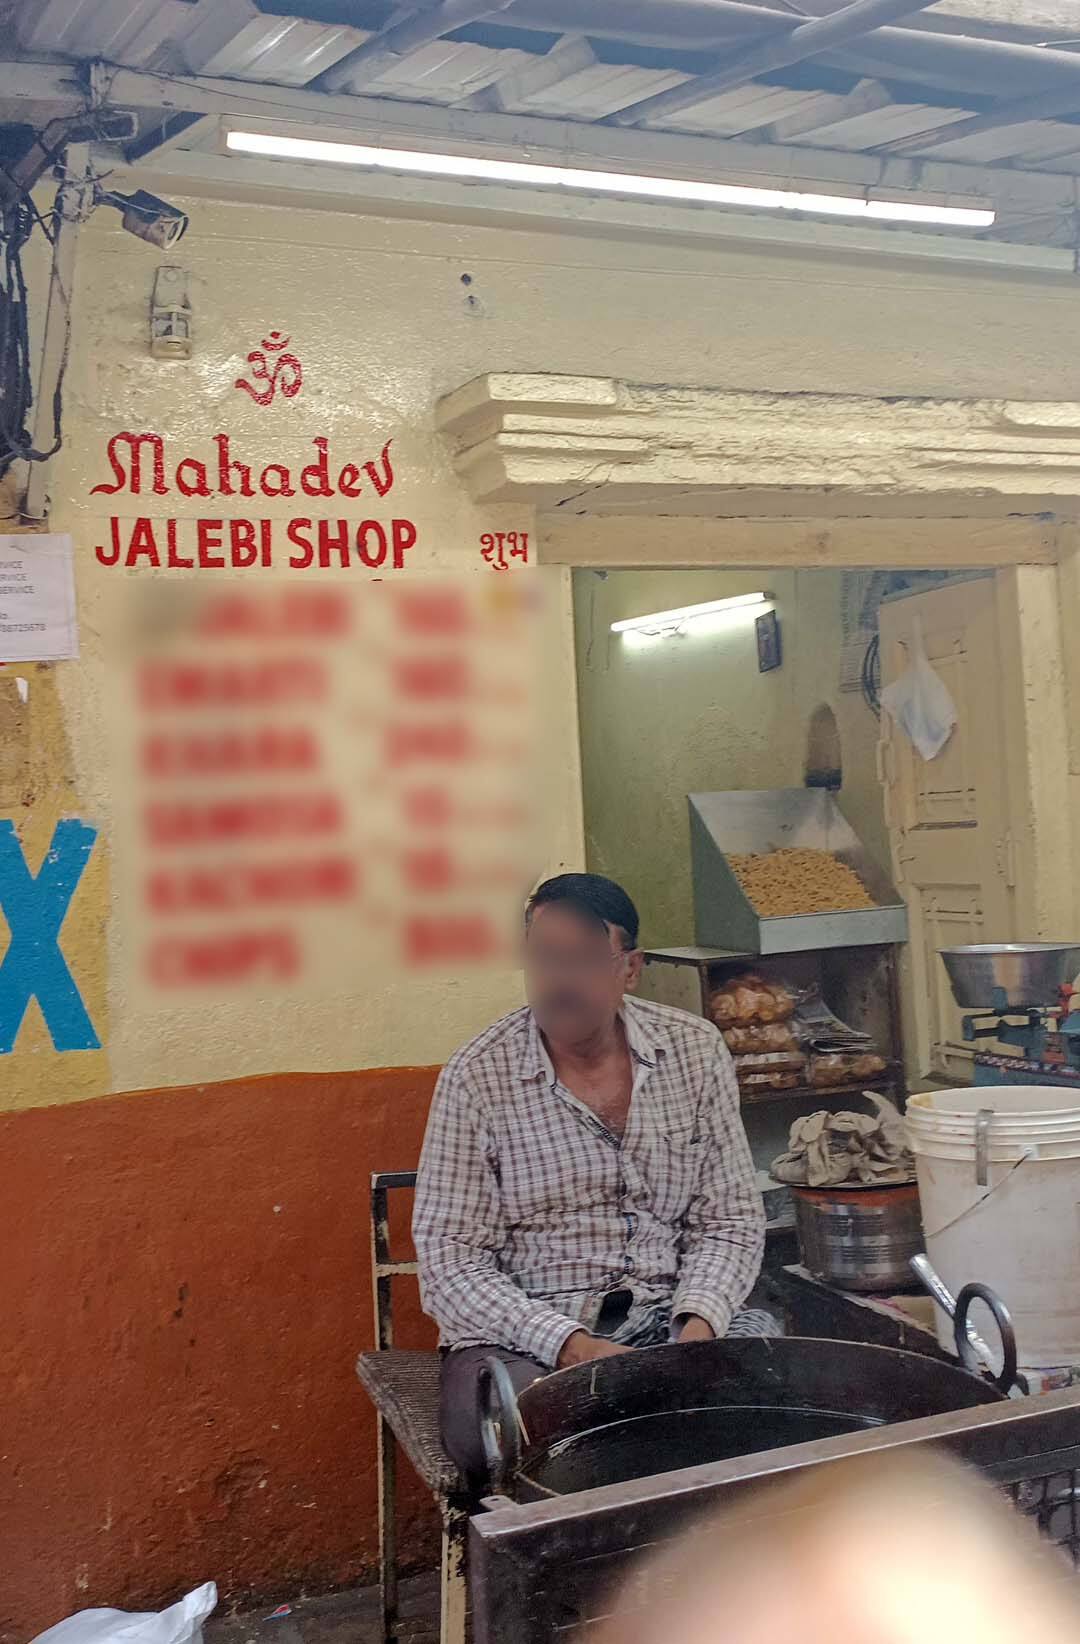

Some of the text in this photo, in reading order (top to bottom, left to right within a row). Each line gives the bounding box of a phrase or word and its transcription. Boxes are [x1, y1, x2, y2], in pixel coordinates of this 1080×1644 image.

[90, 431, 395, 499] Mahadev
[95, 516, 417, 569] JALEBI SHOP
[480, 531, 529, 571] शुभ
